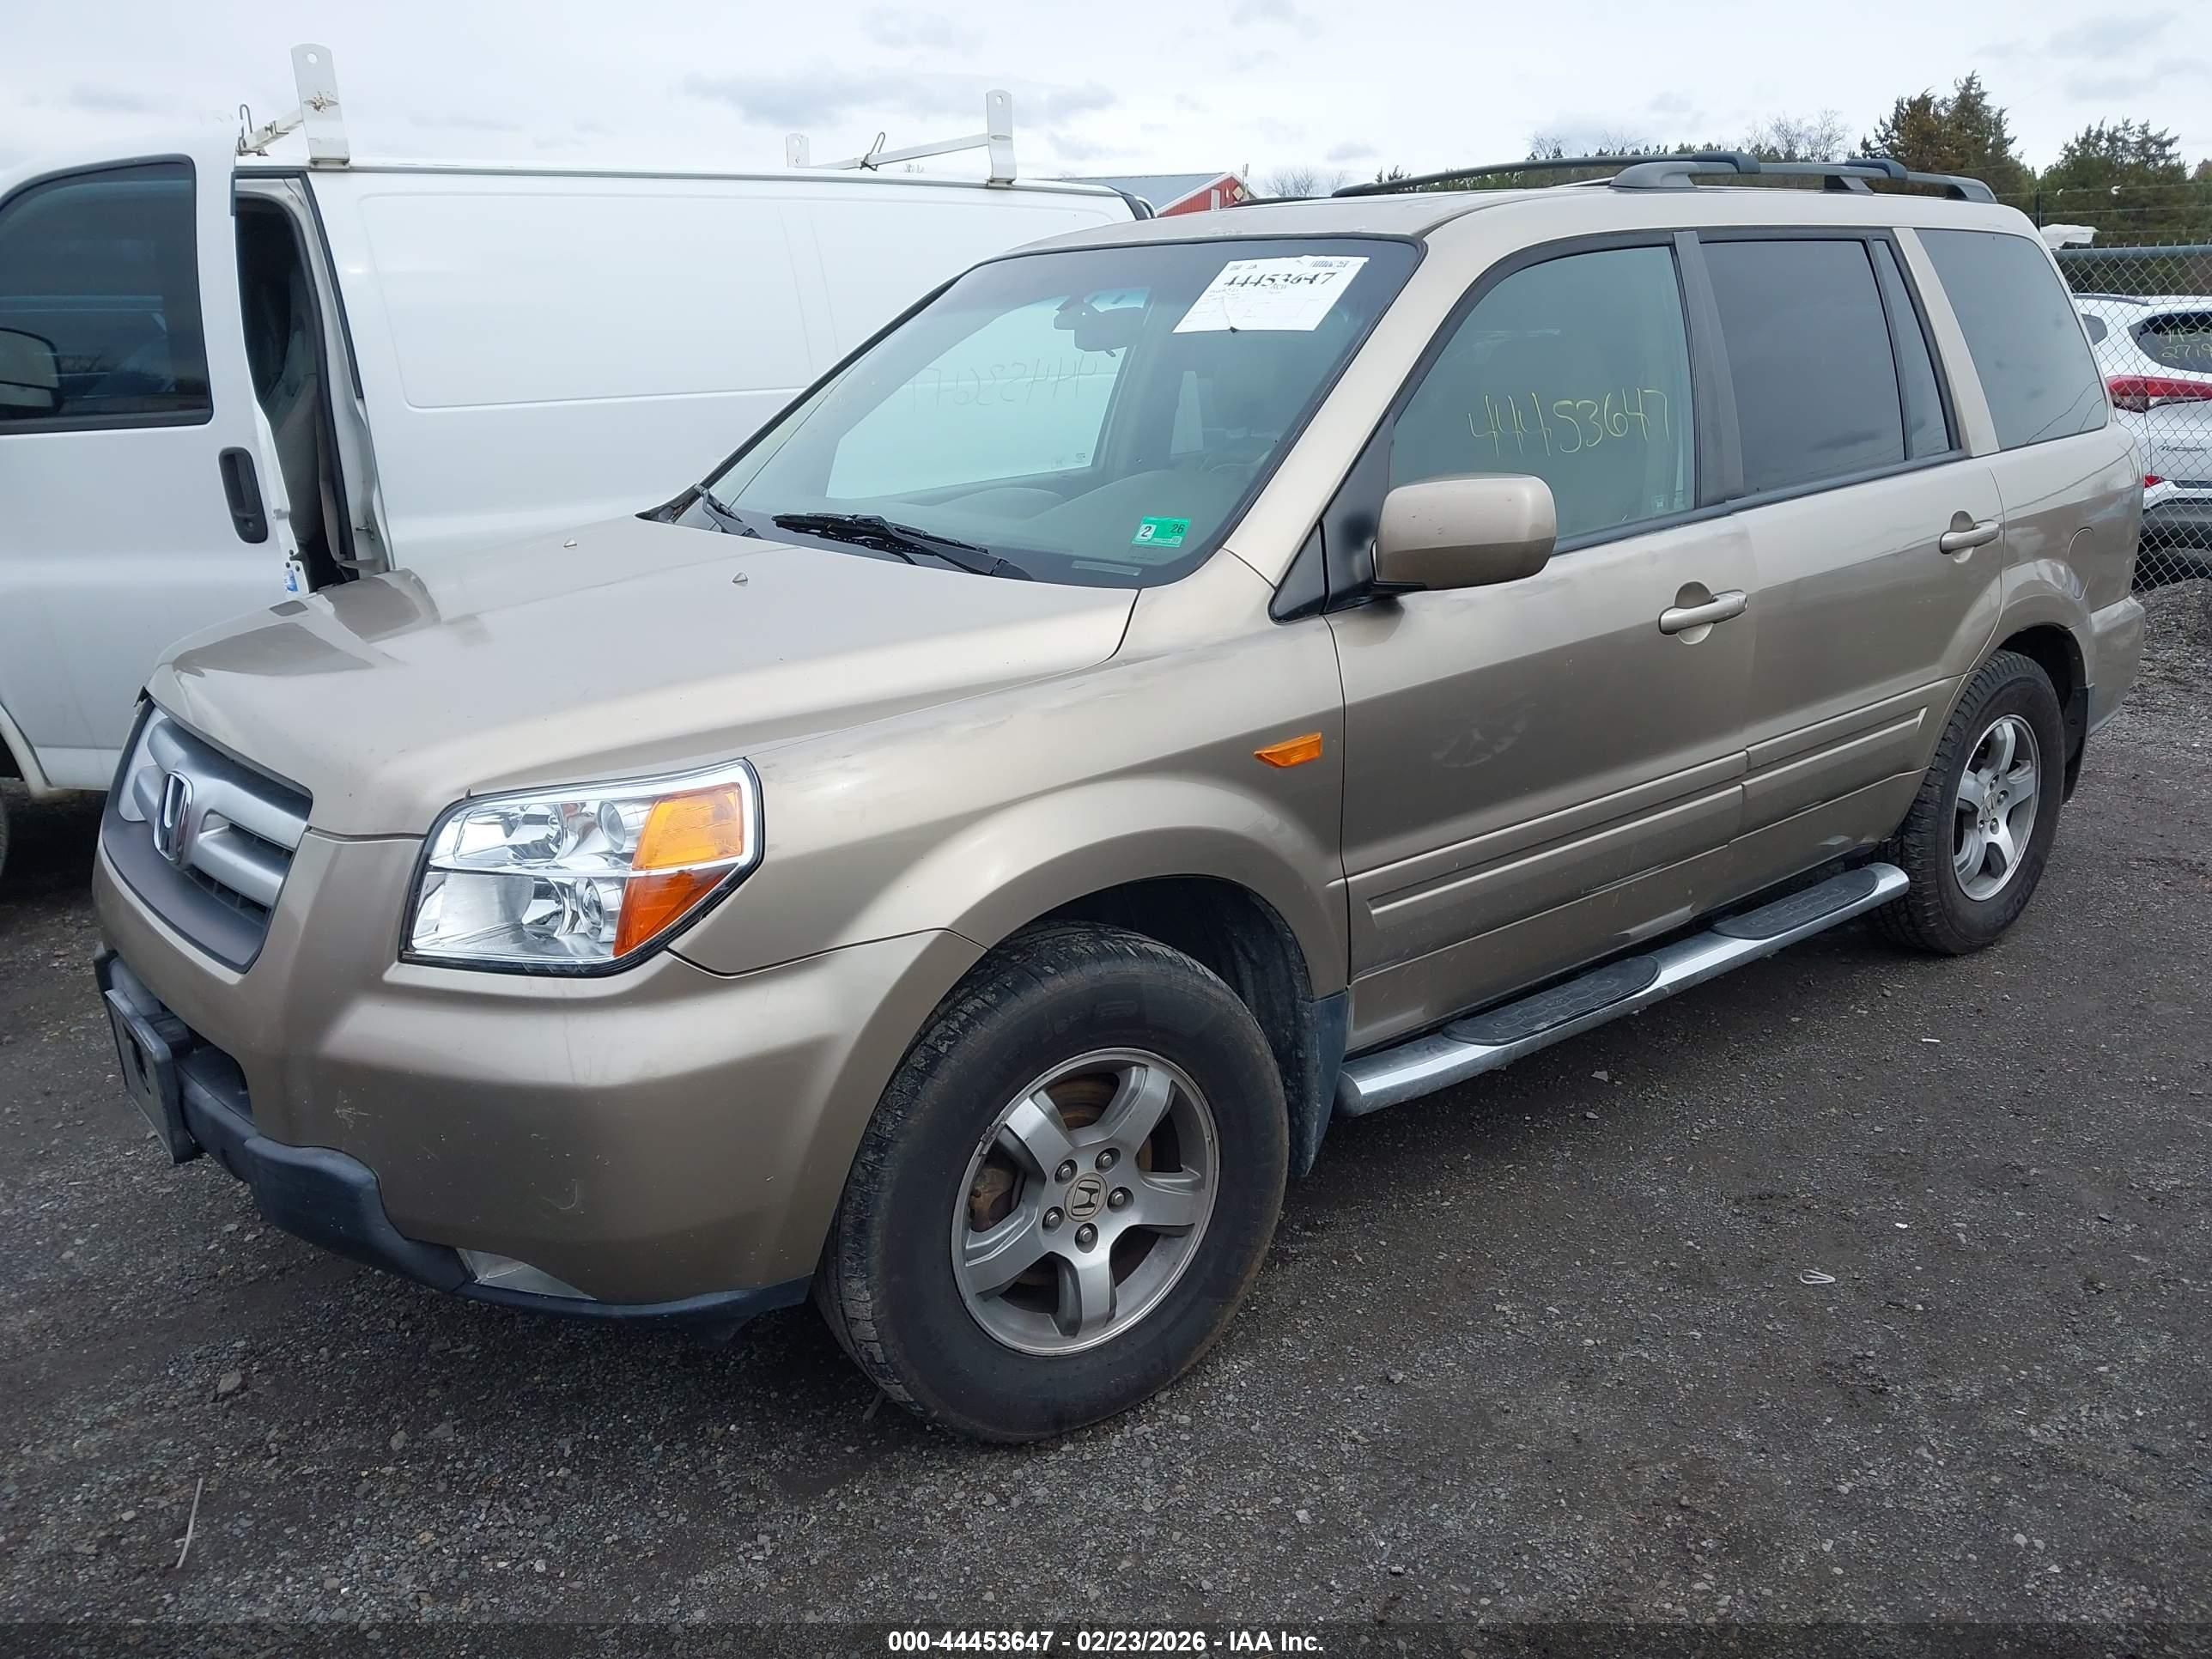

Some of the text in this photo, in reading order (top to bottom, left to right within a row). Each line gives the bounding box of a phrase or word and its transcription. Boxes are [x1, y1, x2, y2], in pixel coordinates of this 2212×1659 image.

[1224, 271, 1337, 288] 44453647
[1468, 387, 1670, 458] 44453647
[1141, 524, 1186, 538] 2 26
